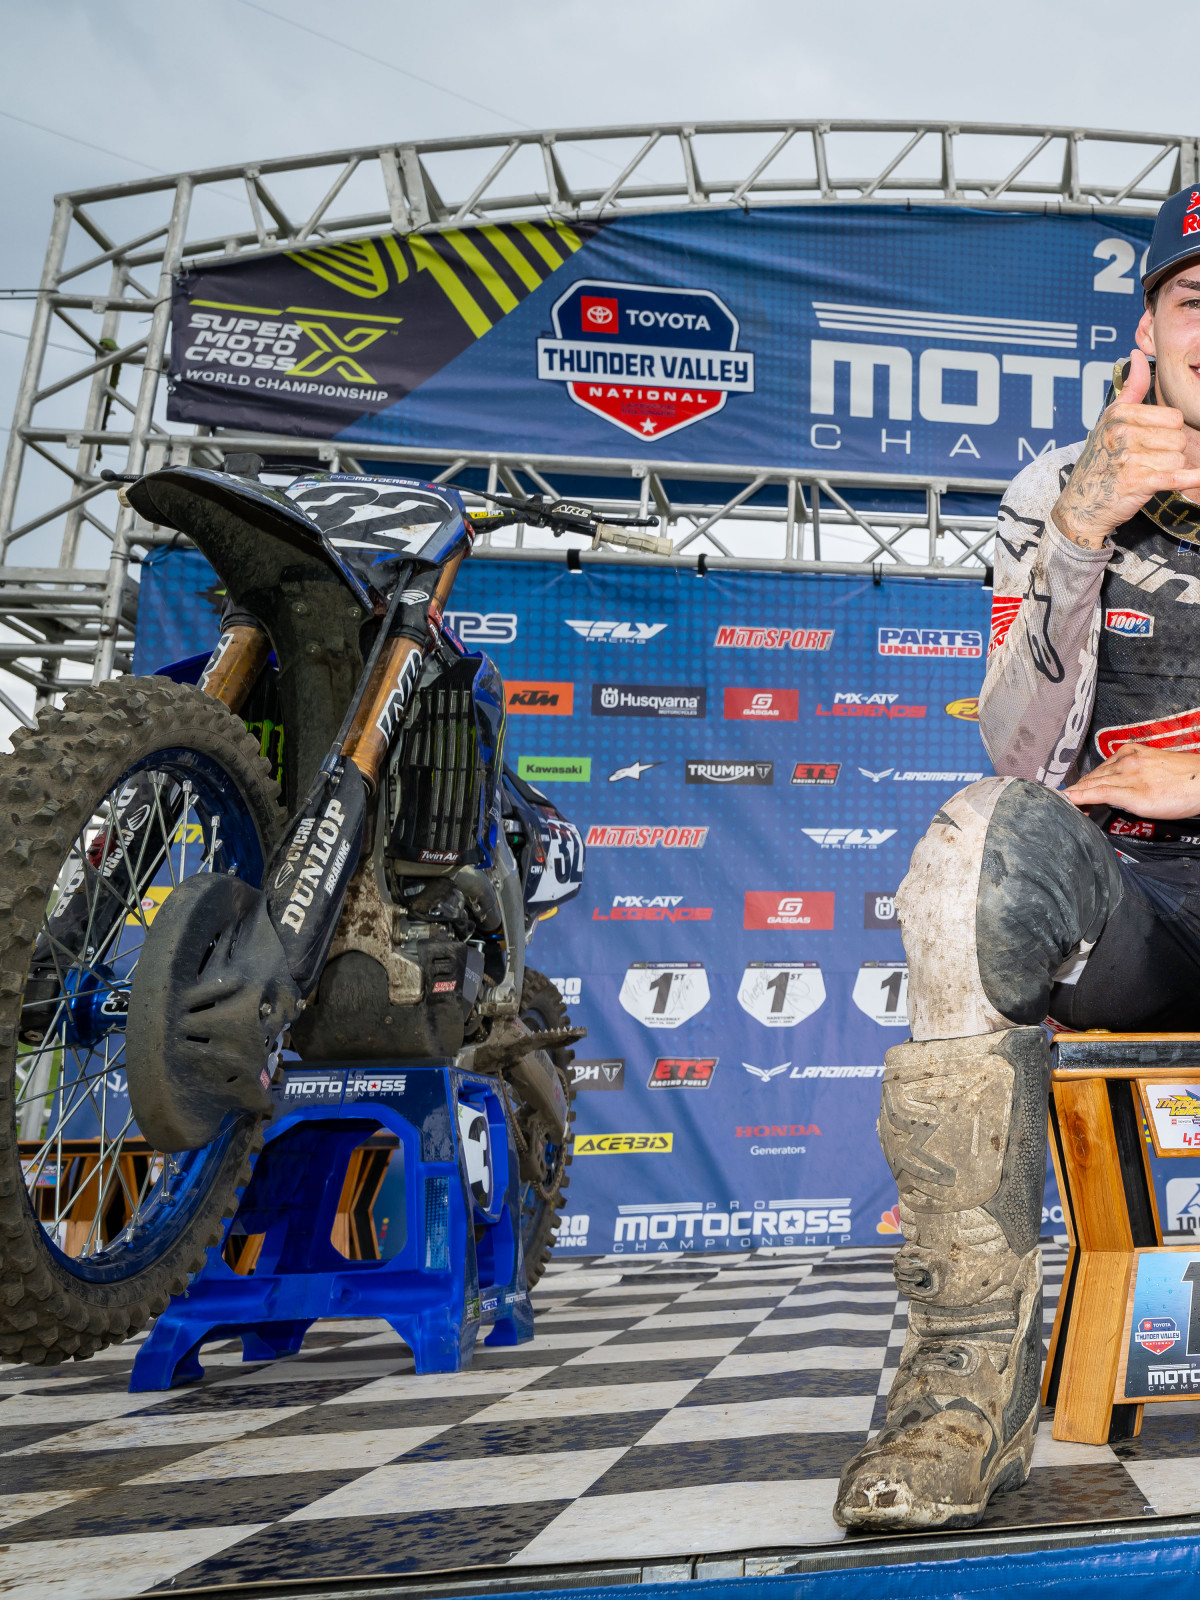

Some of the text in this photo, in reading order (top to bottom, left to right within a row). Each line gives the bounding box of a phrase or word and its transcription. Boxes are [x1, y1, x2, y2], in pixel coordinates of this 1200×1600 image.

[188, 313, 303, 340] SUPER
[626, 309, 711, 331] TOYOTA
[194, 330, 297, 356] MOTO
[185, 346, 298, 372] CROSS
[543, 347, 748, 383] THUNDER VALLEY
[186, 369, 388, 401] WORLD CHAMPIONSHIP
[589, 387, 707, 404] NATIONAL
[552, 503, 592, 518] ARC
[568, 619, 668, 639] FLY
[1109, 614, 1147, 633] 100%
[586, 637, 646, 645] RACING
[880, 629, 981, 645] PARTS
[880, 645, 981, 657] UNLIMITED
[509, 690, 559, 706] KTM
[620, 690, 698, 710] Husqvarna
[743, 709, 779, 717] GASGAS
[816, 703, 927, 720] LEGENDS
[526, 764, 583, 775] Kawasaki
[687, 764, 754, 780] TRIUMPH
[795, 764, 839, 779] ETS
[893, 771, 984, 782] LANDMASTER
[286, 816, 316, 862] CYCRA
[804, 828, 898, 844] FLY
[421, 850, 460, 860] Twin Air
[281, 798, 346, 935] DUNLOP
[324, 838, 351, 896] BRAKING
[592, 907, 713, 923] LEGENDS
[766, 916, 811, 924] GASGAS
[655, 1060, 715, 1079] ETS
[790, 1066, 886, 1079] LANDMAST
[285, 1079, 407, 1094] MOTOCROSS
[651, 1079, 708, 1087] RACING FUELS
[734, 1125, 823, 1138] HONDA
[577, 1137, 669, 1152] ACERBIS
[750, 1145, 806, 1156] Generators
[707, 1200, 766, 1211] PRO
[613, 1209, 852, 1242] MOTOCROSS
[613, 1235, 852, 1253] CHAMPIONSHIP
[1136, 1332, 1180, 1341] THUNDER VALLEY
